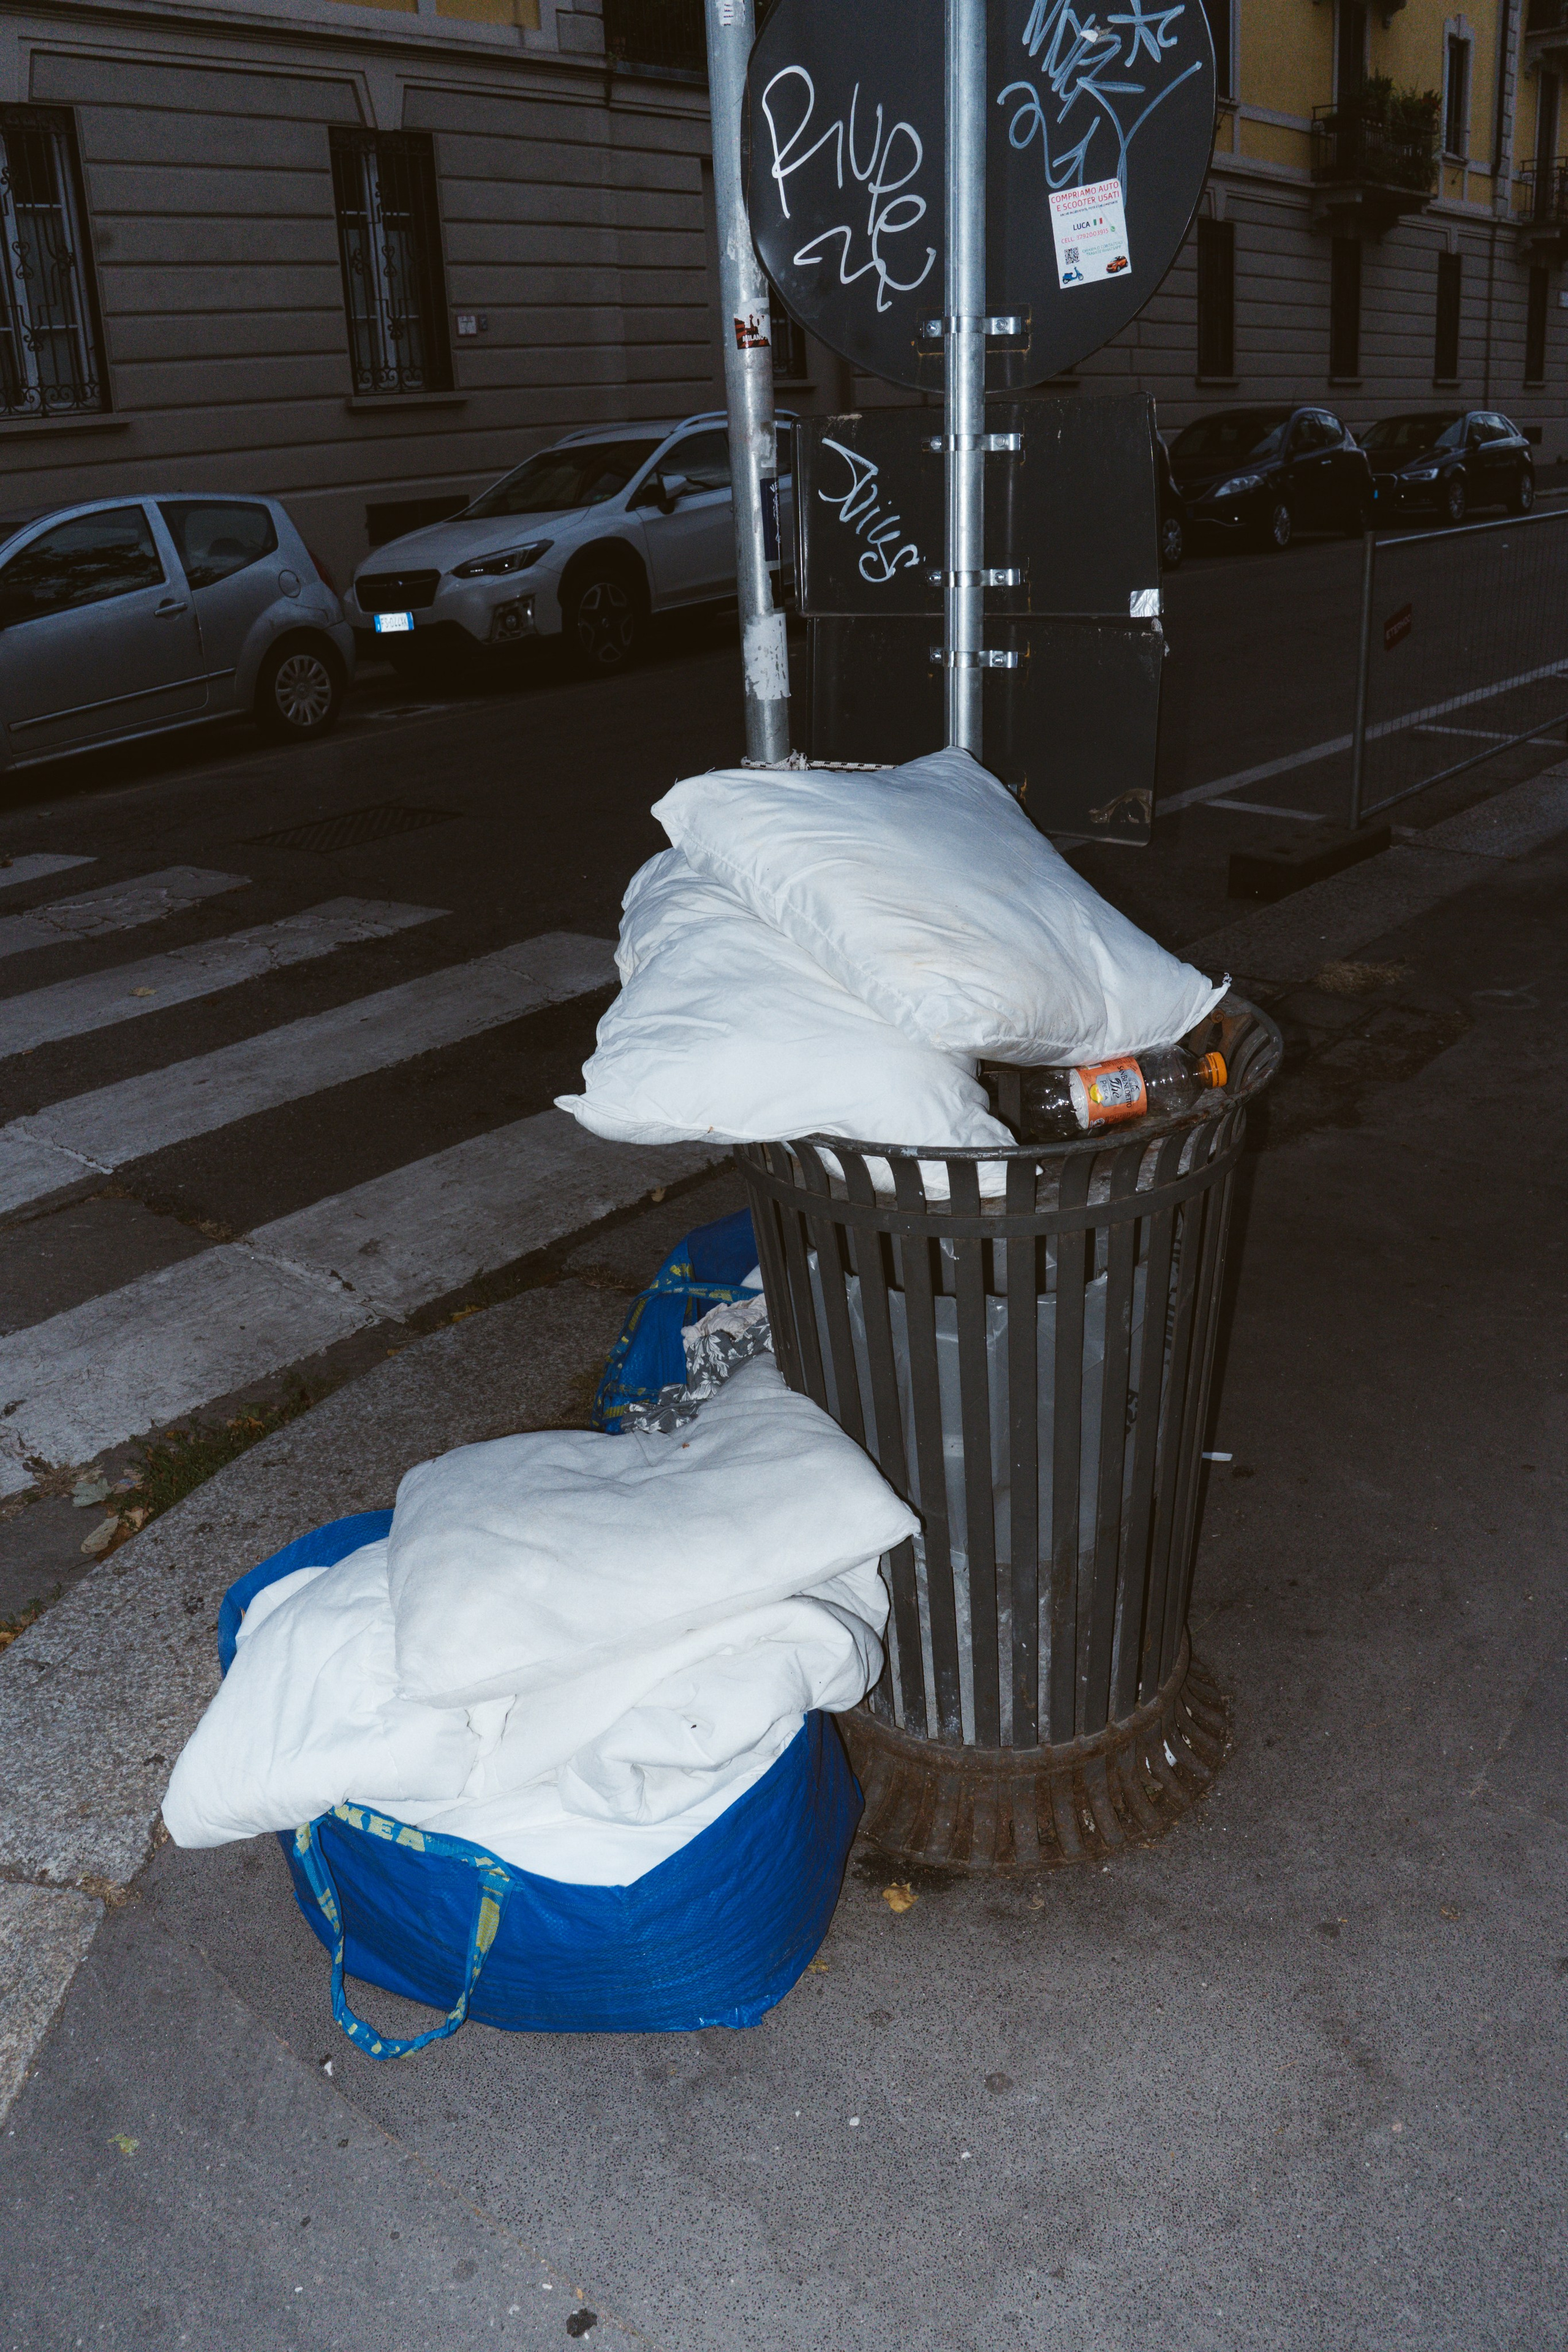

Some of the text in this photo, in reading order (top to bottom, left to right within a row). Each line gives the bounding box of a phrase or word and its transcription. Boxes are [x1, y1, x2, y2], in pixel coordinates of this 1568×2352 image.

[1051, 181, 1119, 204] COMPRIAMO AUTO
[1063, 196, 1096, 211] SCOOTER
[1098, 190, 1120, 202] USATI
[1073, 221, 1091, 231] LUCA
[1077, 228, 1109, 241] 3792003915
[742, 333, 764, 342] MILANO
[1100, 1080, 1109, 1101] PESCA
[328, 1804, 426, 1852] KEA
